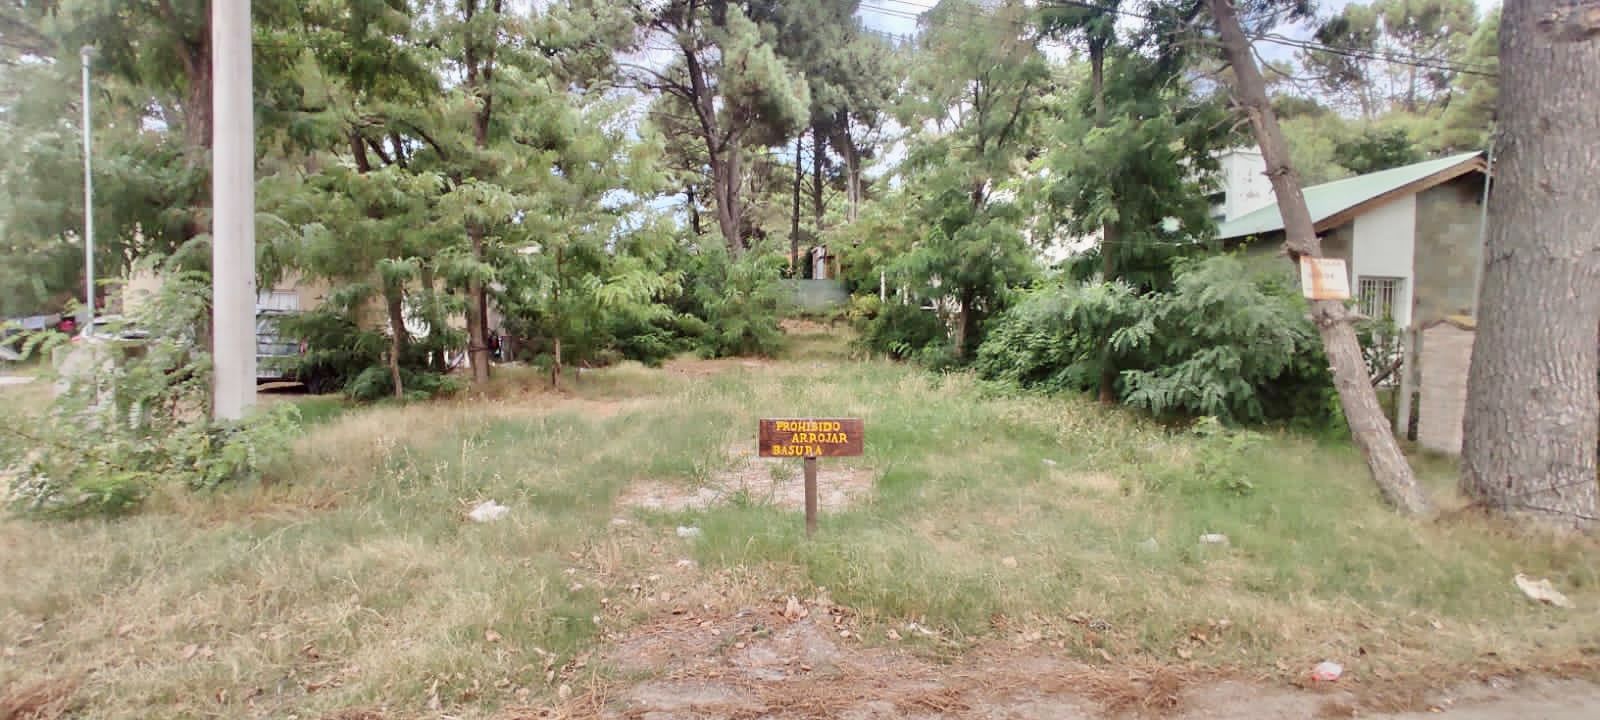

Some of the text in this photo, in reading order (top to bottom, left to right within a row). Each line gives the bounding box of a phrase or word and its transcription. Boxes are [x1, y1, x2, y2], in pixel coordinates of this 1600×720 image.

[775, 421, 840, 432] PROHIBIDO
[791, 432, 848, 443] ARROJAR
[772, 444, 823, 456] BASURA
